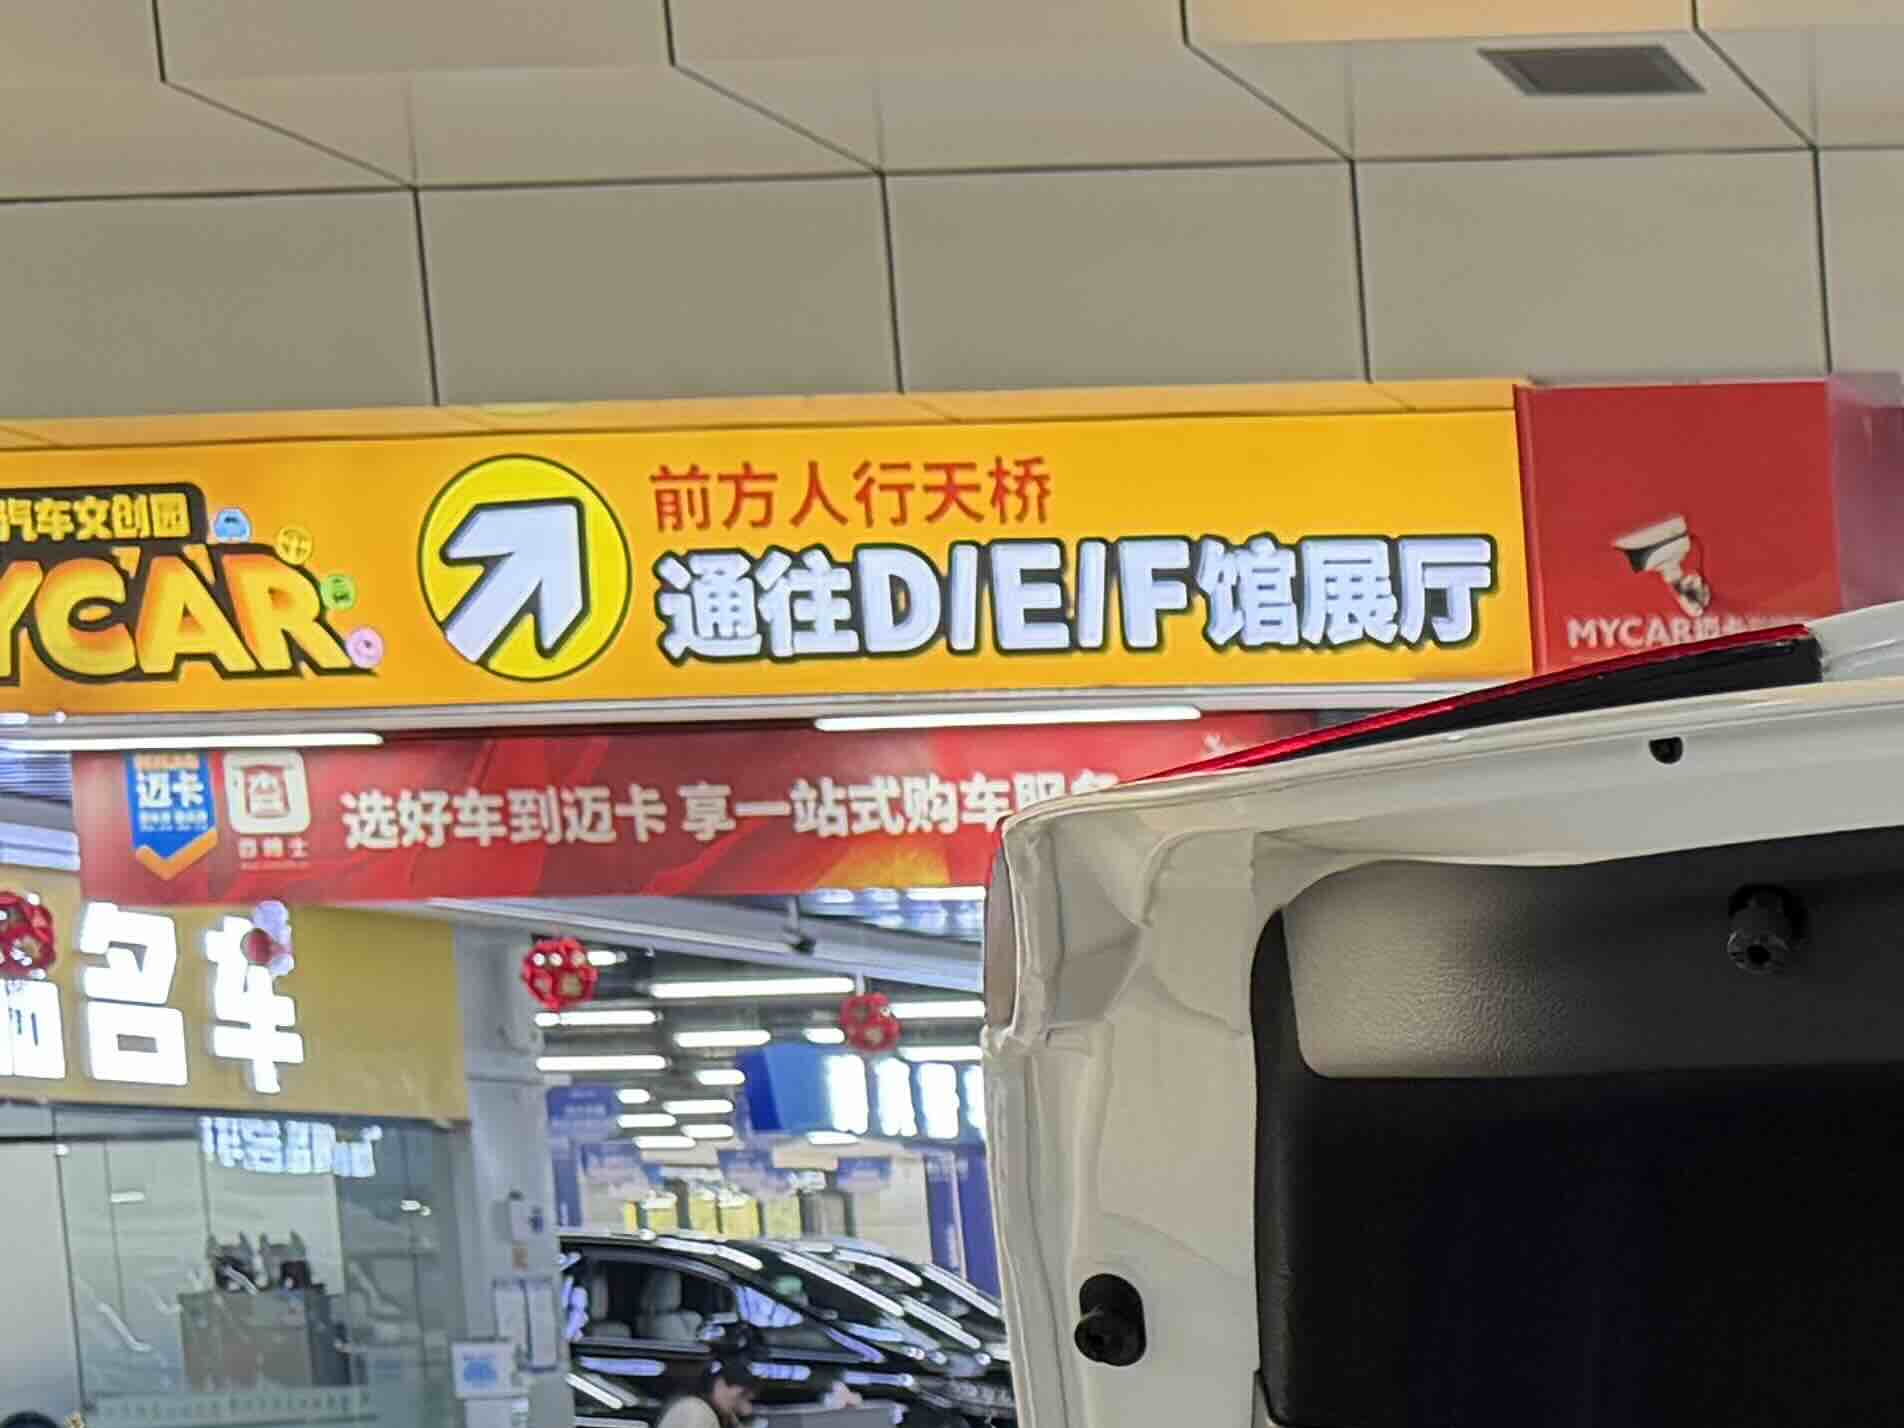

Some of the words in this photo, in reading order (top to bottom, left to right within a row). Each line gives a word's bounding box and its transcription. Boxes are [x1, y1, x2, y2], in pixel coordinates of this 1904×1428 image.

[649, 455, 1052, 533] 前方人行天桥
[340, 782, 668, 852] 选好车到迈卡
